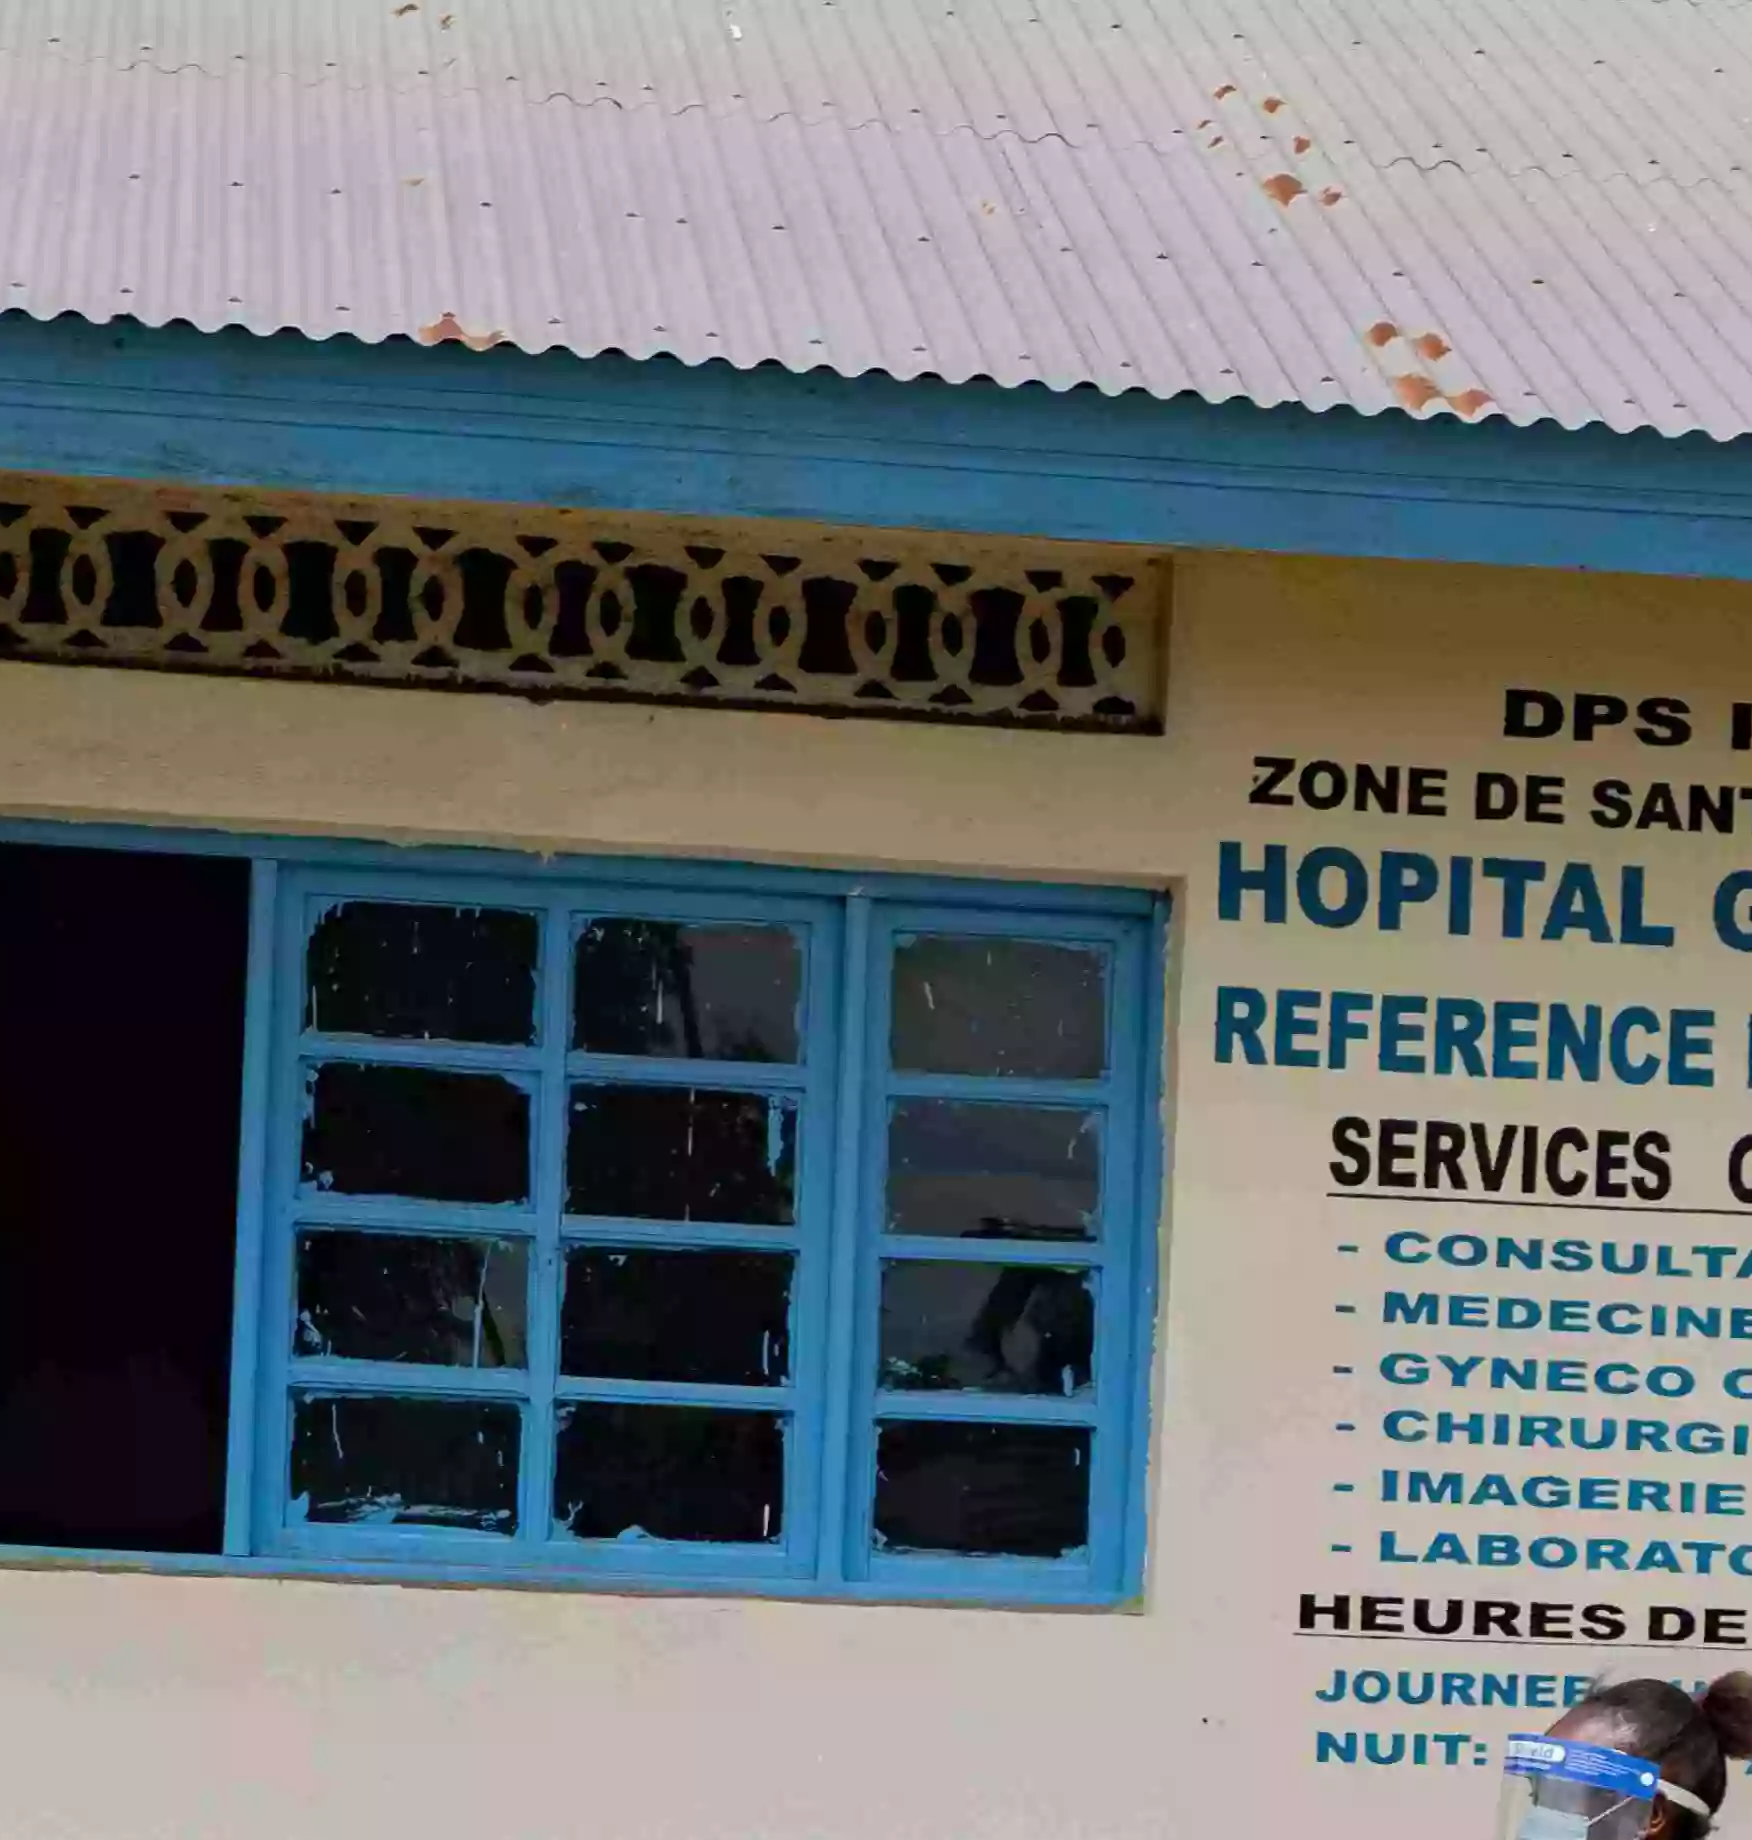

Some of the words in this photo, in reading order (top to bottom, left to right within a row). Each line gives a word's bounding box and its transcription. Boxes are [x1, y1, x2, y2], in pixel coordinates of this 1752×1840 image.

[1504, 689, 1691, 746] DPS
[1249, 757, 1447, 816] ZONE
[1476, 772, 1564, 824] DE
[1219, 842, 1674, 947] HOPITAL
[1215, 986, 1715, 1087] REFERENCE
[1329, 1117, 1671, 1201] SERVICES
[1380, 1353, 1695, 1397] GYNECO
[1382, 1470, 1745, 1515] IMAGERIE
[1300, 1594, 1626, 1645] HEURES
[1648, 1606, 1746, 1644] DE
[1317, 1732, 1487, 1765] NUIT:
